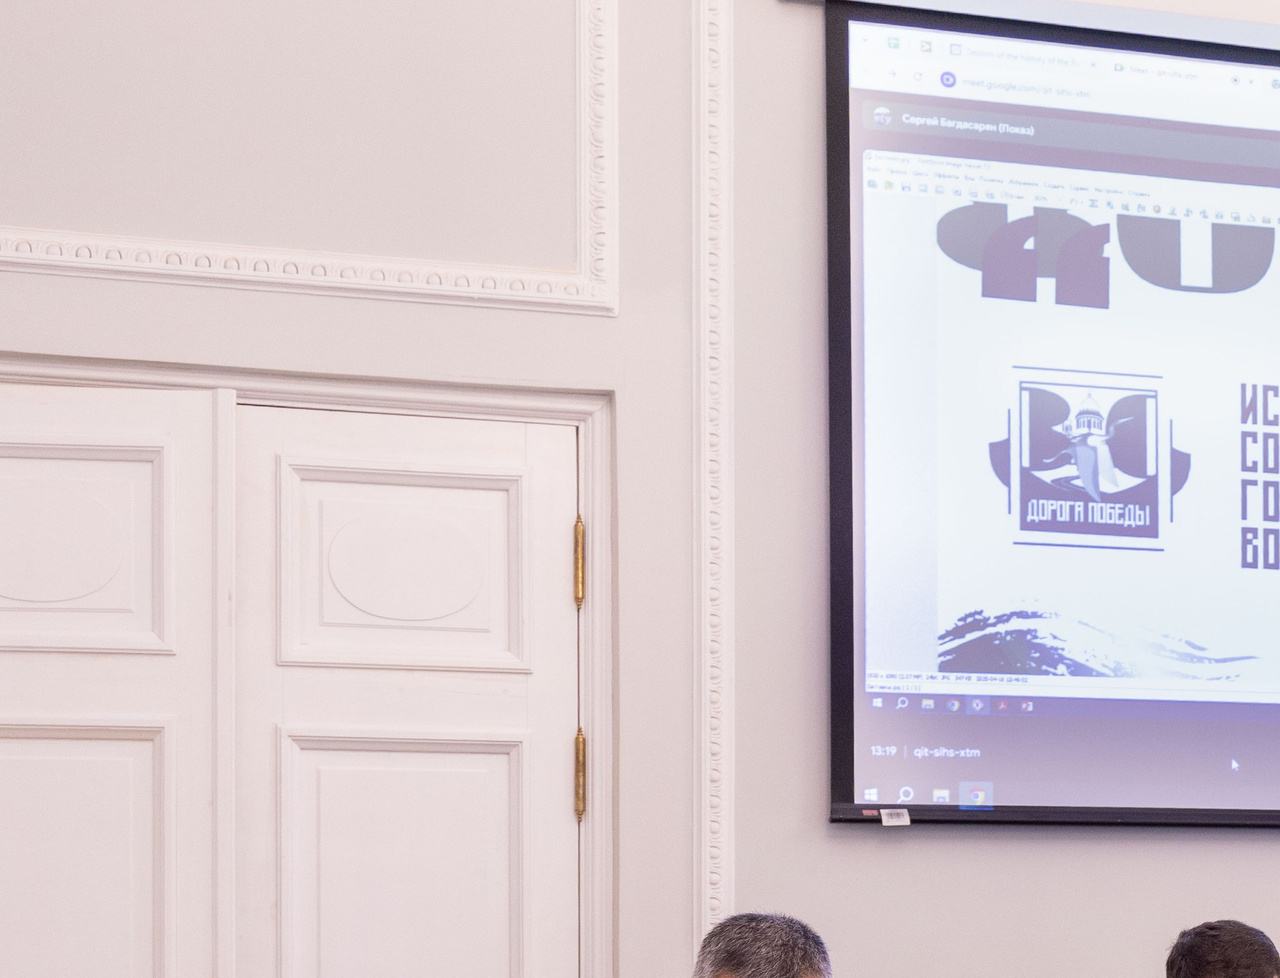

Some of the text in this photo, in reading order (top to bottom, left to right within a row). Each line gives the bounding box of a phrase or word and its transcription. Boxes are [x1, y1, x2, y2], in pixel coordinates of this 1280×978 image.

[902, 113, 1035, 136] Сергей Багдасарян (Показ)
[1026, 498, 1150, 528] ДОРОГА ПОБЕДЫ
[870, 745, 981, 759] 13:19 qit-sihs-xtm
